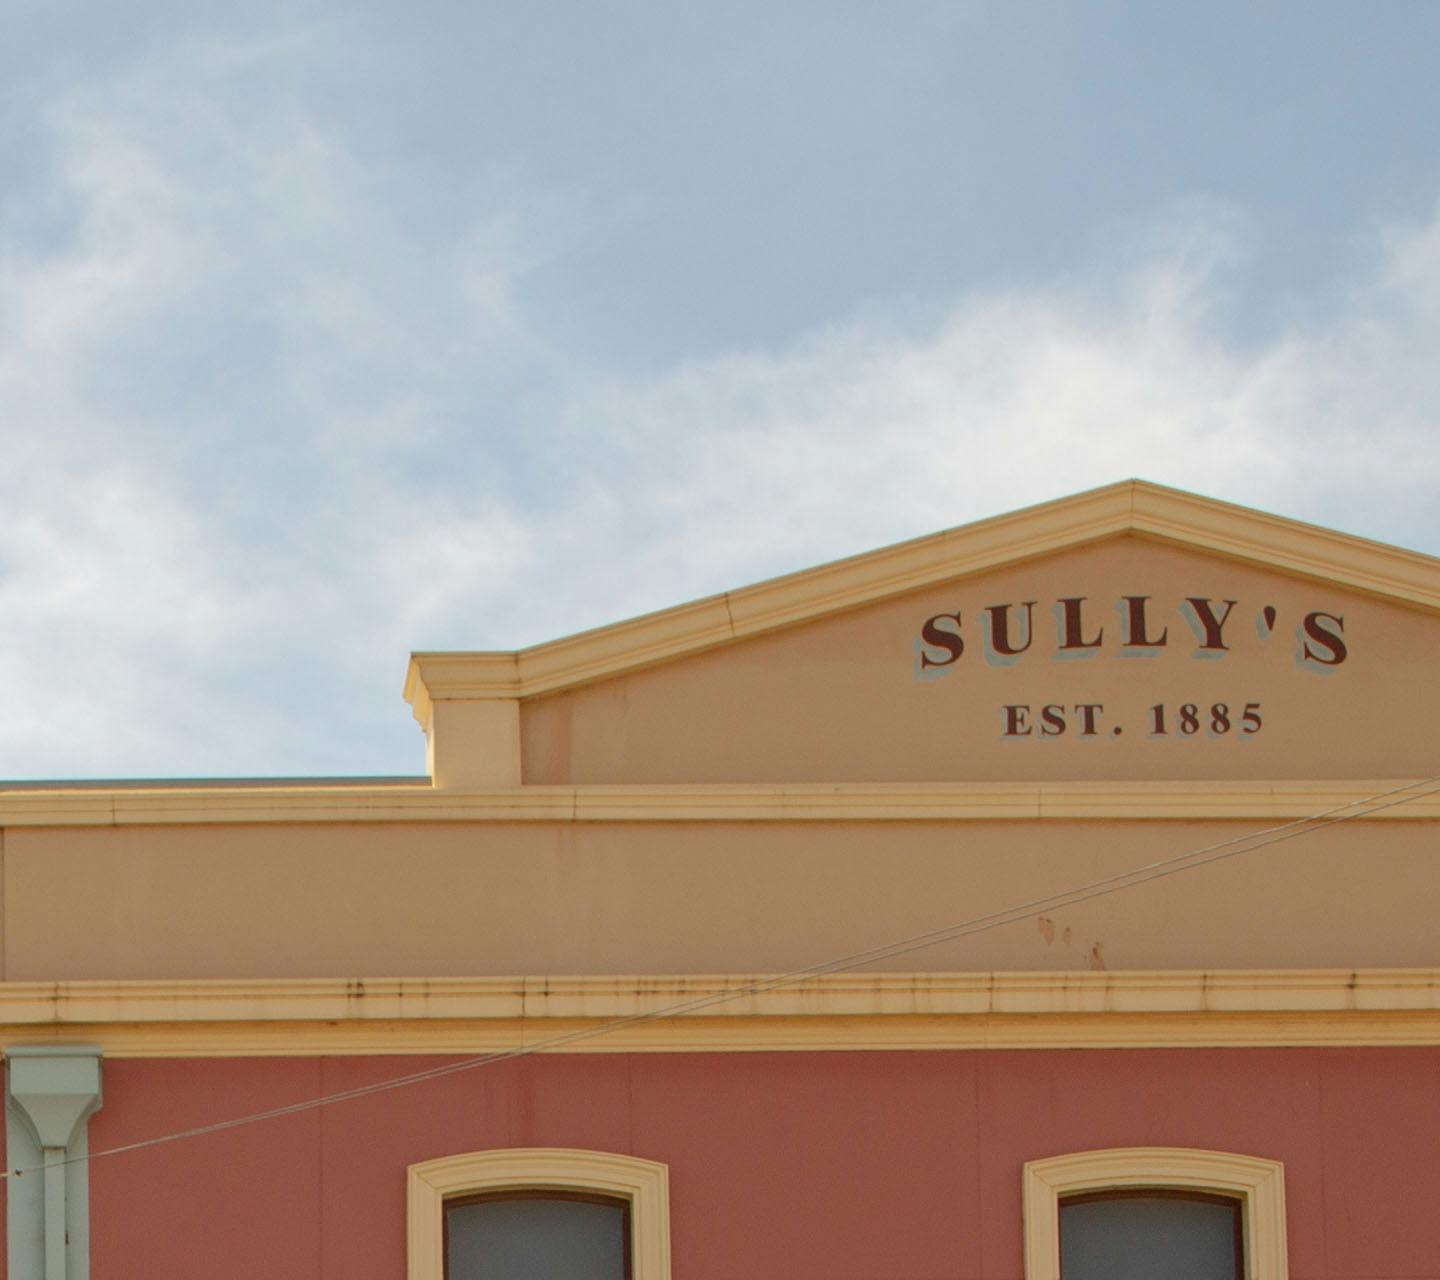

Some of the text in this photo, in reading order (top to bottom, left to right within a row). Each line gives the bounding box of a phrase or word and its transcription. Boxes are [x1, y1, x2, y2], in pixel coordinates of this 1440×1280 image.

[917, 596, 1348, 676] SULLY'S
[1002, 702, 1263, 736] EST. 1885
